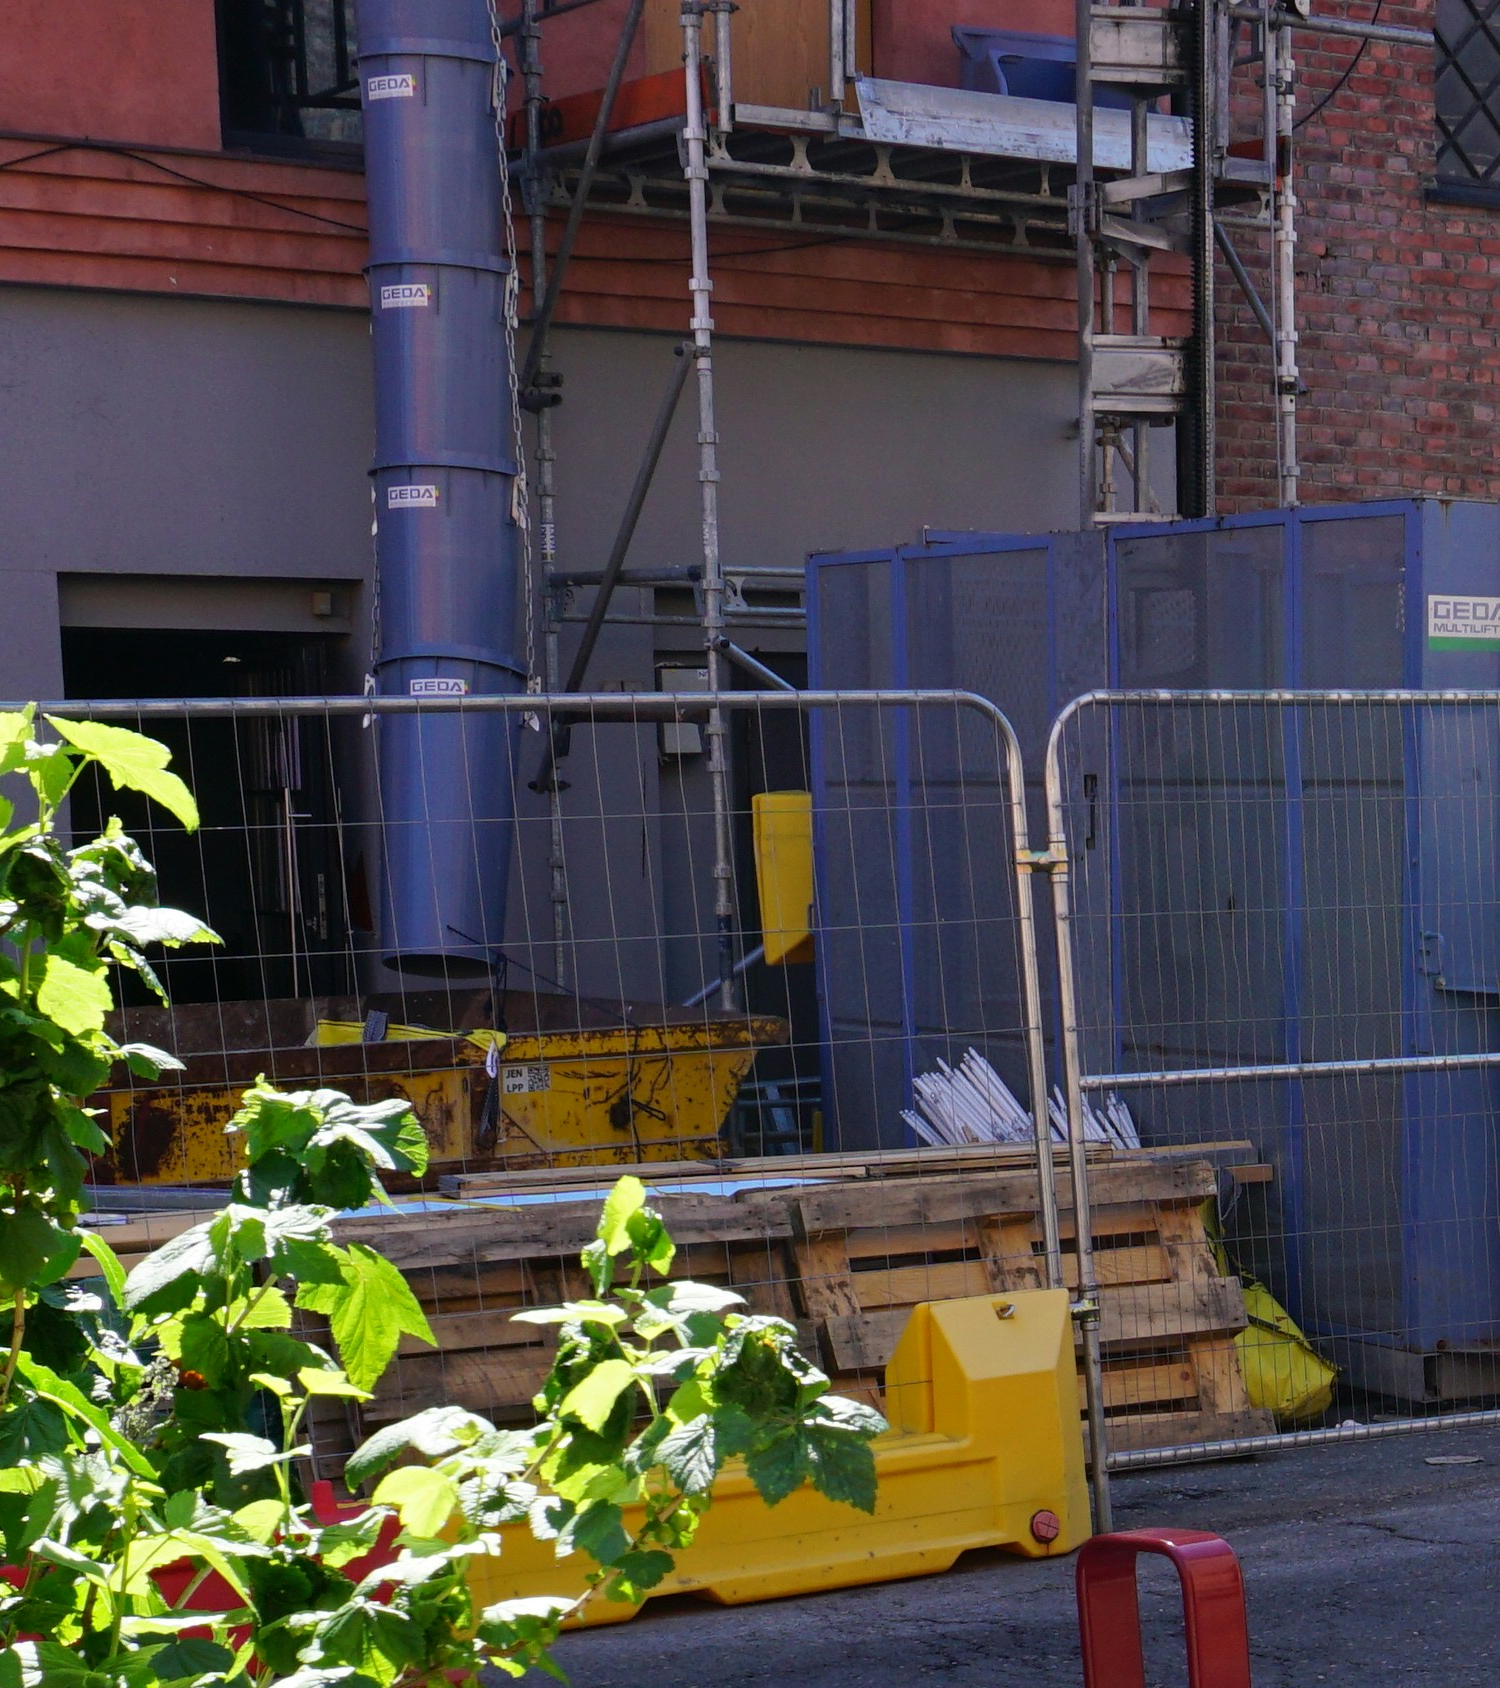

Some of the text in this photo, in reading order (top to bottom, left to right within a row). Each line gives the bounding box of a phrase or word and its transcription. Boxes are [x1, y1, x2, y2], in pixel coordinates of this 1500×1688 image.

[369, 78, 410, 92] GEDA
[383, 287, 426, 300] GEDA
[389, 488, 433, 500] GEDA
[1433, 622, 1500, 634] MULTILIFT
[412, 681, 463, 692] GEDA
[506, 1068, 523, 1079] JEN
[506, 1083, 524, 1093] LPP
